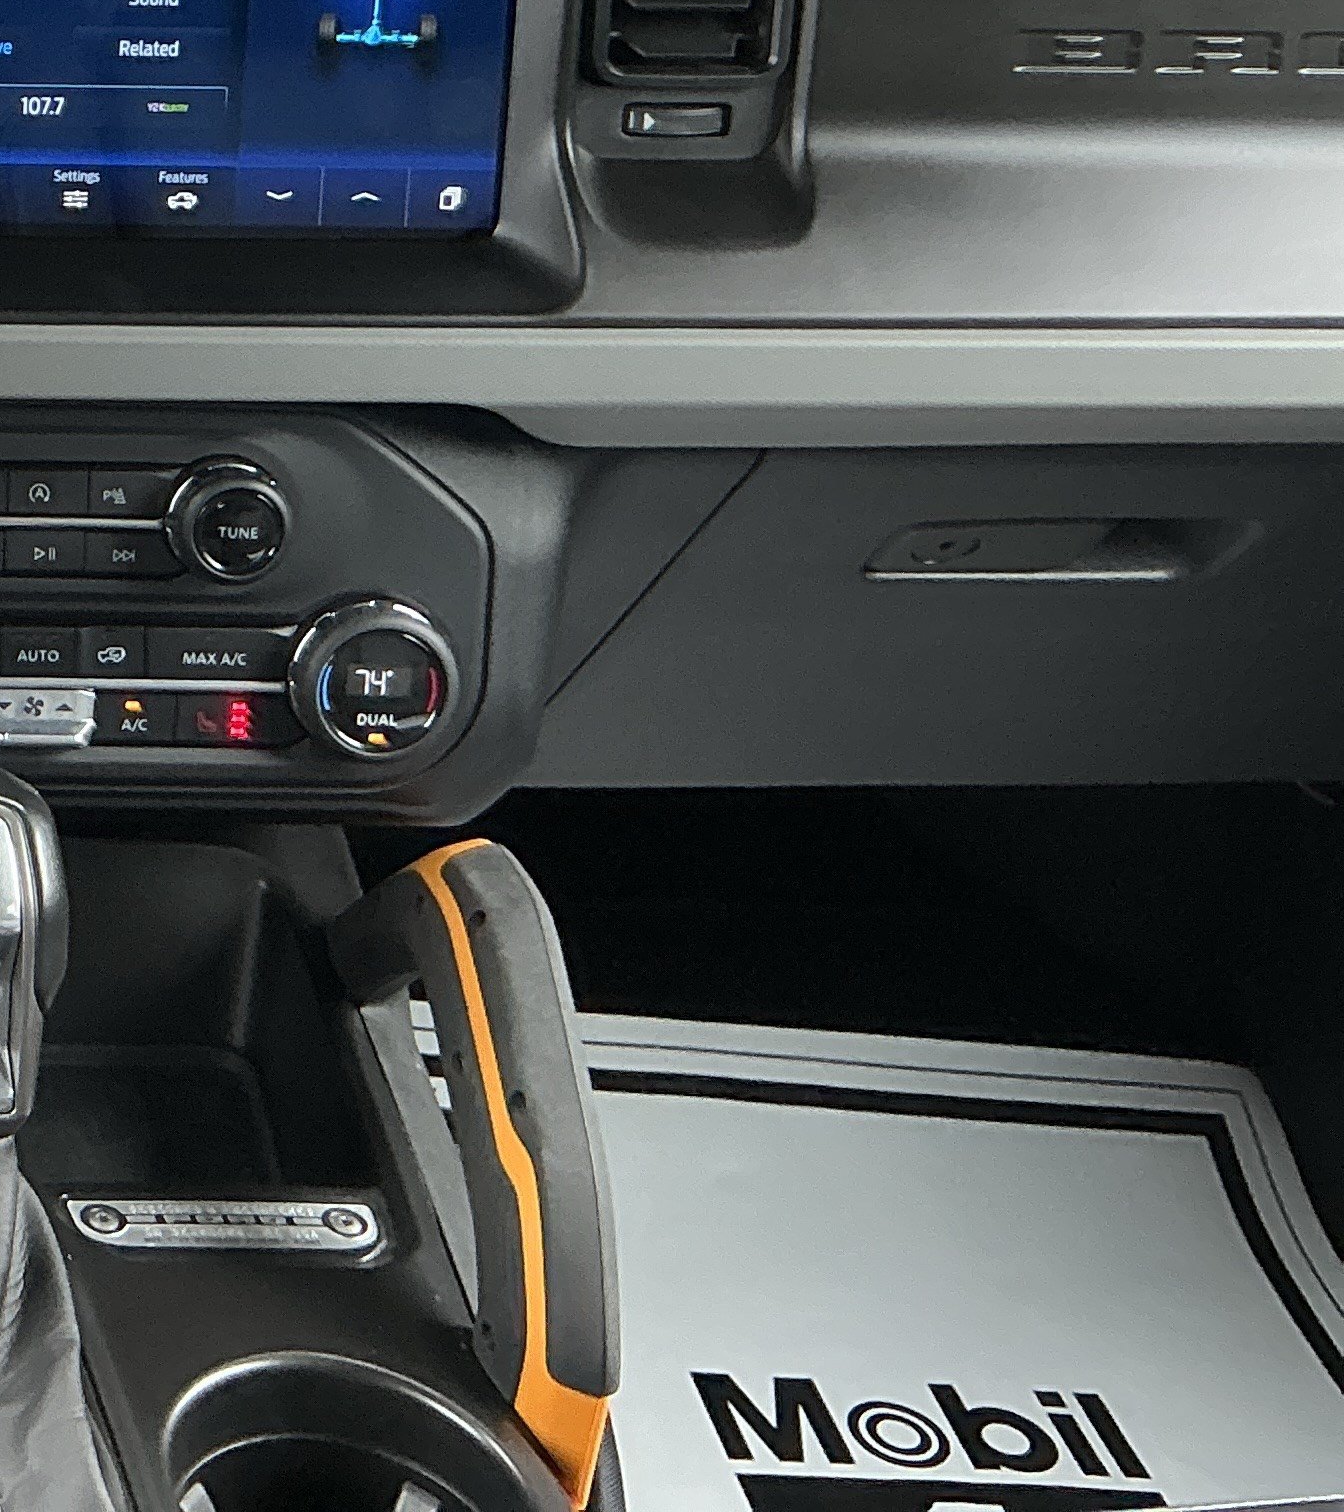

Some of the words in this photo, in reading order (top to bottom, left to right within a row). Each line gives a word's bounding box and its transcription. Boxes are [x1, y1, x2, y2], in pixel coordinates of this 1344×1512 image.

[119, 39, 179, 57] Related
[20, 96, 65, 116] 107.7
[53, 169, 100, 185] Settings
[158, 171, 209, 185] Features
[217, 525, 259, 541] TUNE
[17, 648, 60, 663] AUTO
[182, 652, 217, 666] MAX
[220, 652, 248, 667] A/C
[120, 718, 148, 733] A/C
[356, 713, 399, 728] DUAL
[689, 1371, 1152, 1481] Mobil
